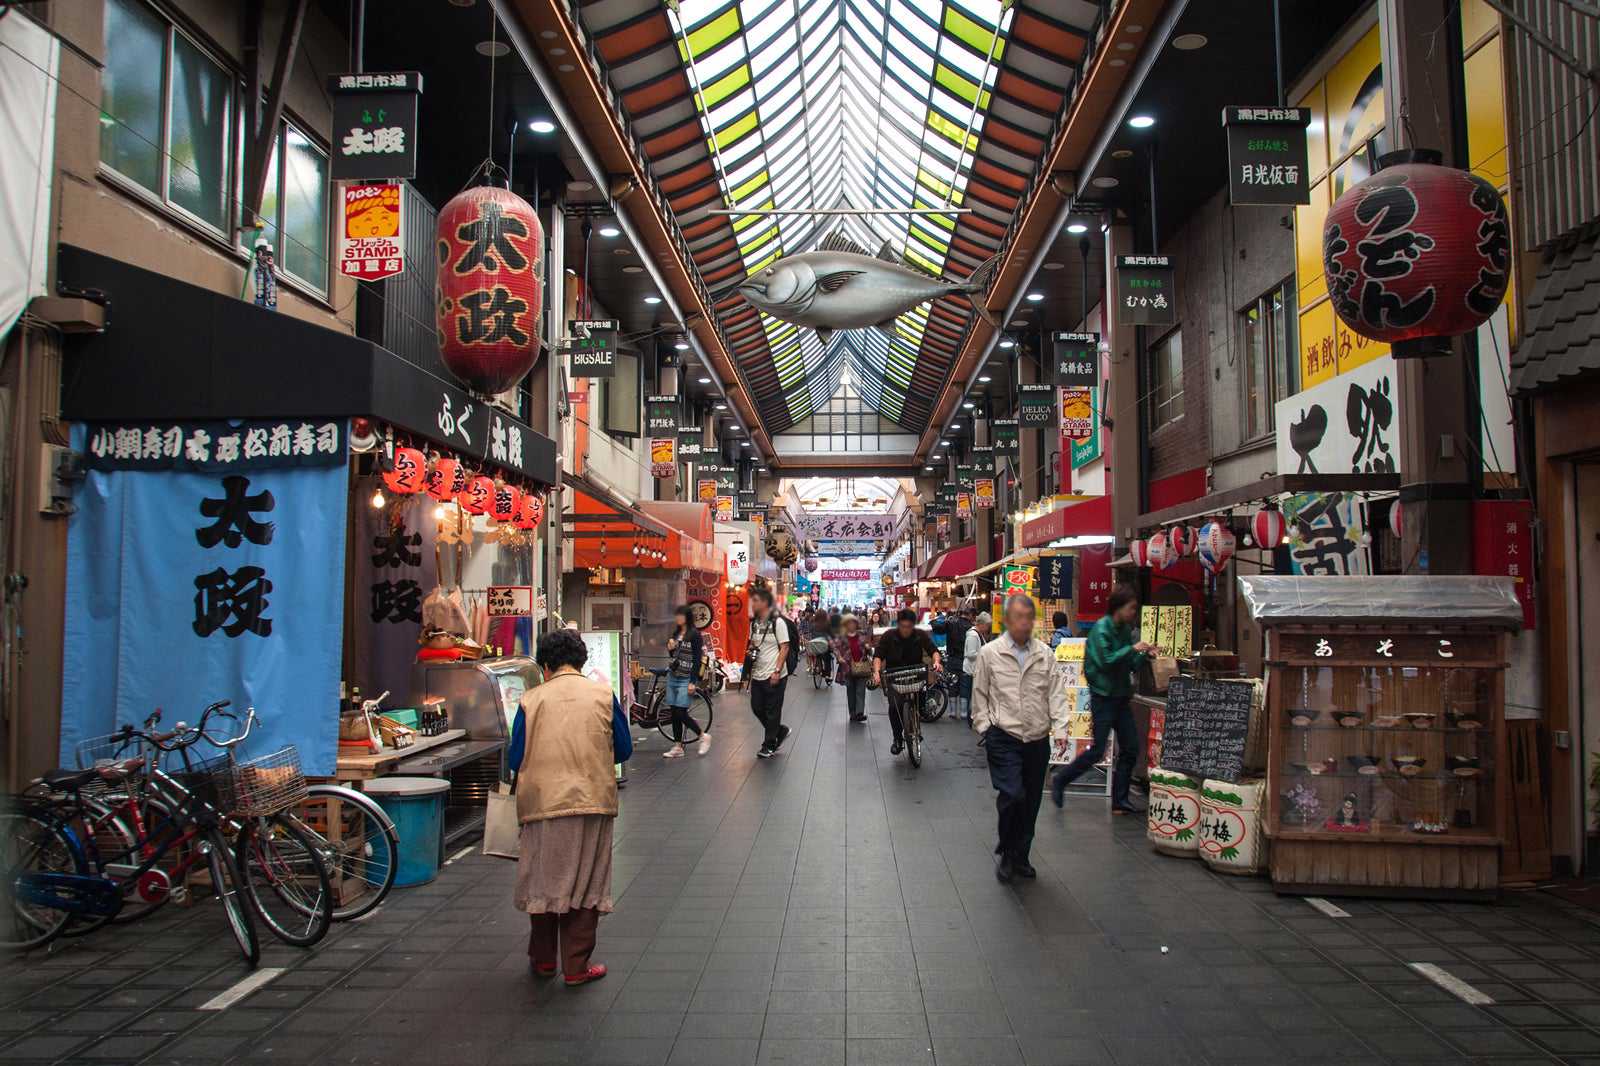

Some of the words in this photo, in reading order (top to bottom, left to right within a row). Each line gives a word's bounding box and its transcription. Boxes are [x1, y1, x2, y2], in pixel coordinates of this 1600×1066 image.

[340, 74, 407, 88] 黒門市場
[1238, 108, 1300, 121] 黒門市場
[1241, 164, 1299, 185] 月光仮面
[350, 238, 393, 248] フレッシュ
[345, 247, 399, 258] STAMP
[345, 260, 400, 273] 加盟店
[1124, 256, 1169, 266] 黒門市場
[1307, 329, 1379, 377] 酒飲みの
[1022, 405, 1052, 414] DELICA
[438, 392, 474, 446] ふぐ
[1025, 413, 1049, 421] COCO
[244, 422, 340, 458] 松前寿司
[1506, 521, 1519, 576] 消火器
[191, 474, 276, 638] 太政
[1314, 638, 1455, 657] あそこ
